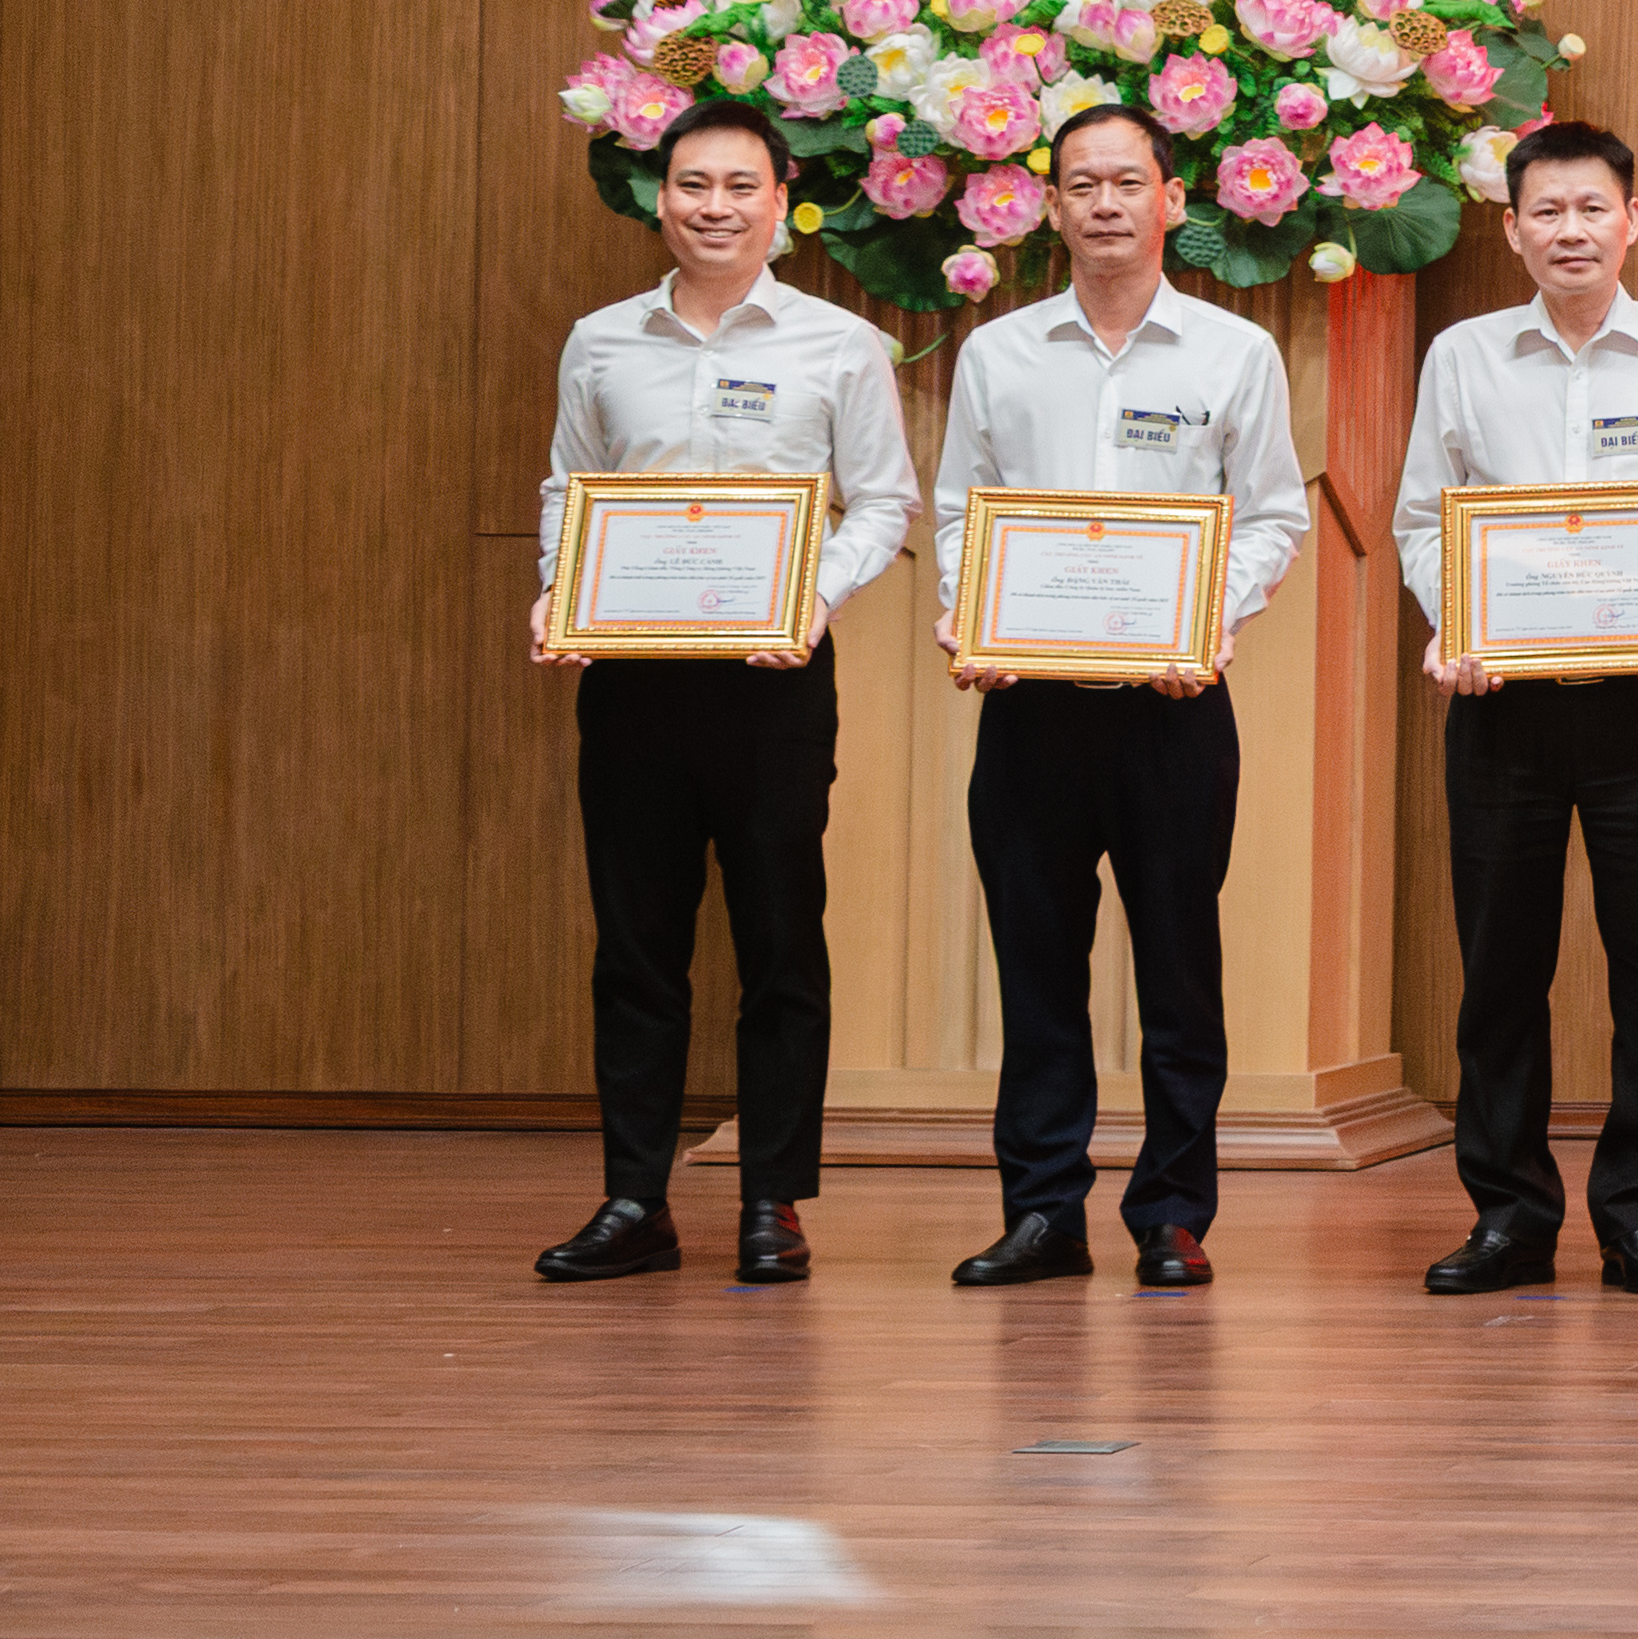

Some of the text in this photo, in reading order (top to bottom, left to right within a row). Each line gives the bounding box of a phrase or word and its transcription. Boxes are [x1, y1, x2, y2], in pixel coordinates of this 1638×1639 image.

[1126, 428, 1171, 443] ĐẠI BIỂU
[1600, 436, 1618, 450] ĐẠI
[1547, 558, 1602, 569] GIẤY KHEN
